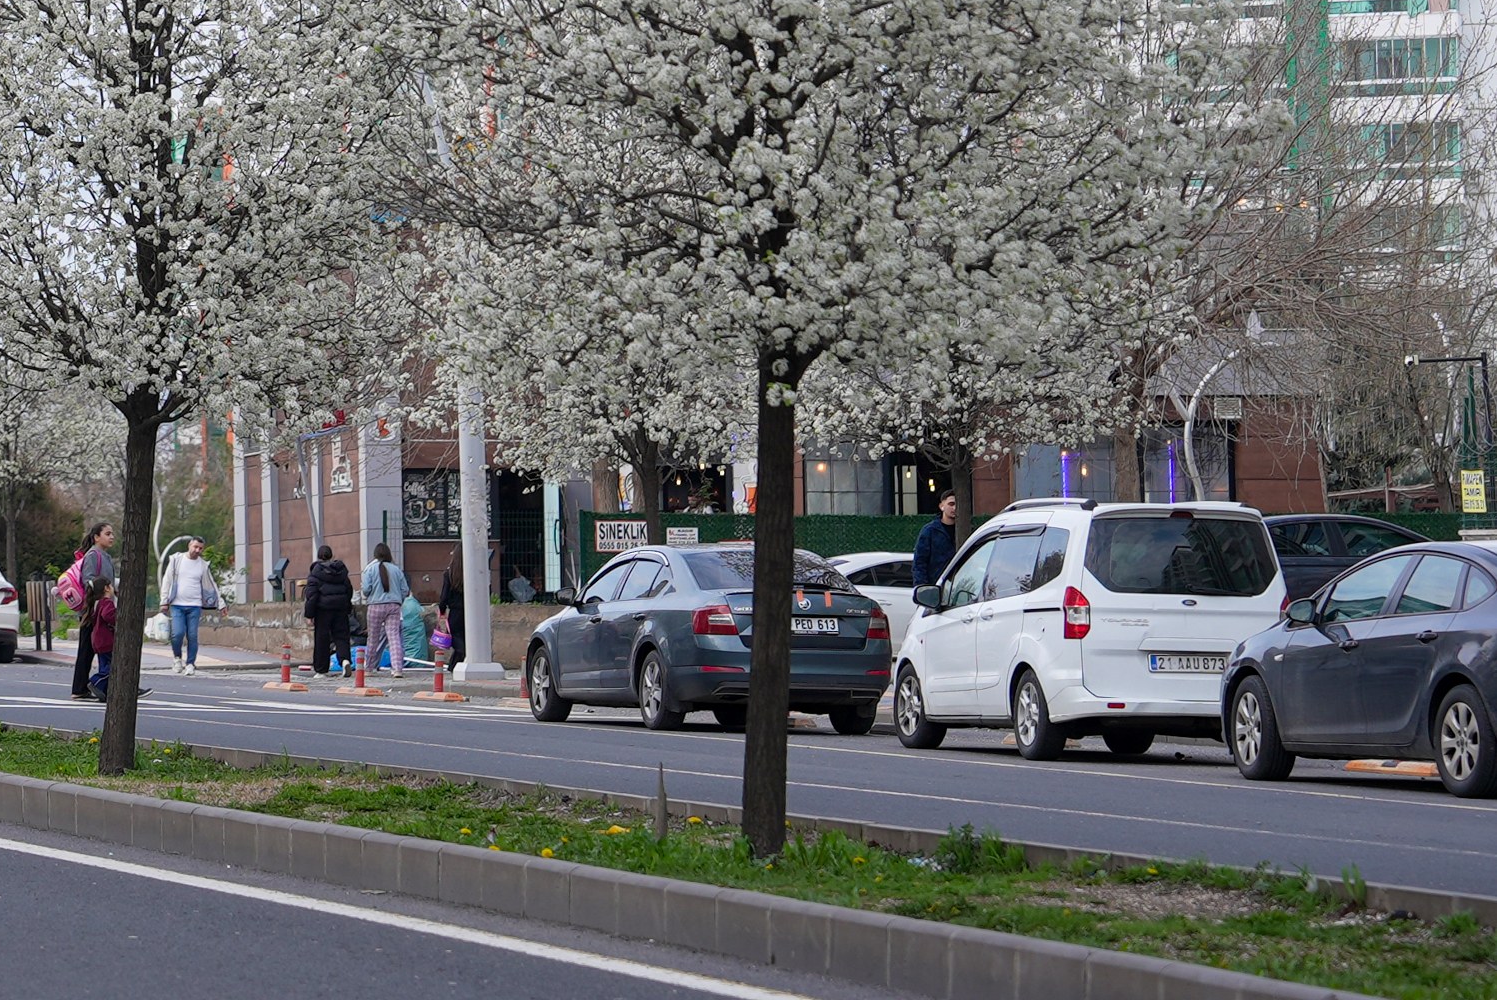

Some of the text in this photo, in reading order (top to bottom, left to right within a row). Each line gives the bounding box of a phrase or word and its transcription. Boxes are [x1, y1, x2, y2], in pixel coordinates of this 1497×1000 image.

[599, 542, 615, 550] 0555
[616, 542, 628, 550] 015
[818, 619, 836, 630] 613
[1158, 657, 1225, 670] 21 AAU 873
